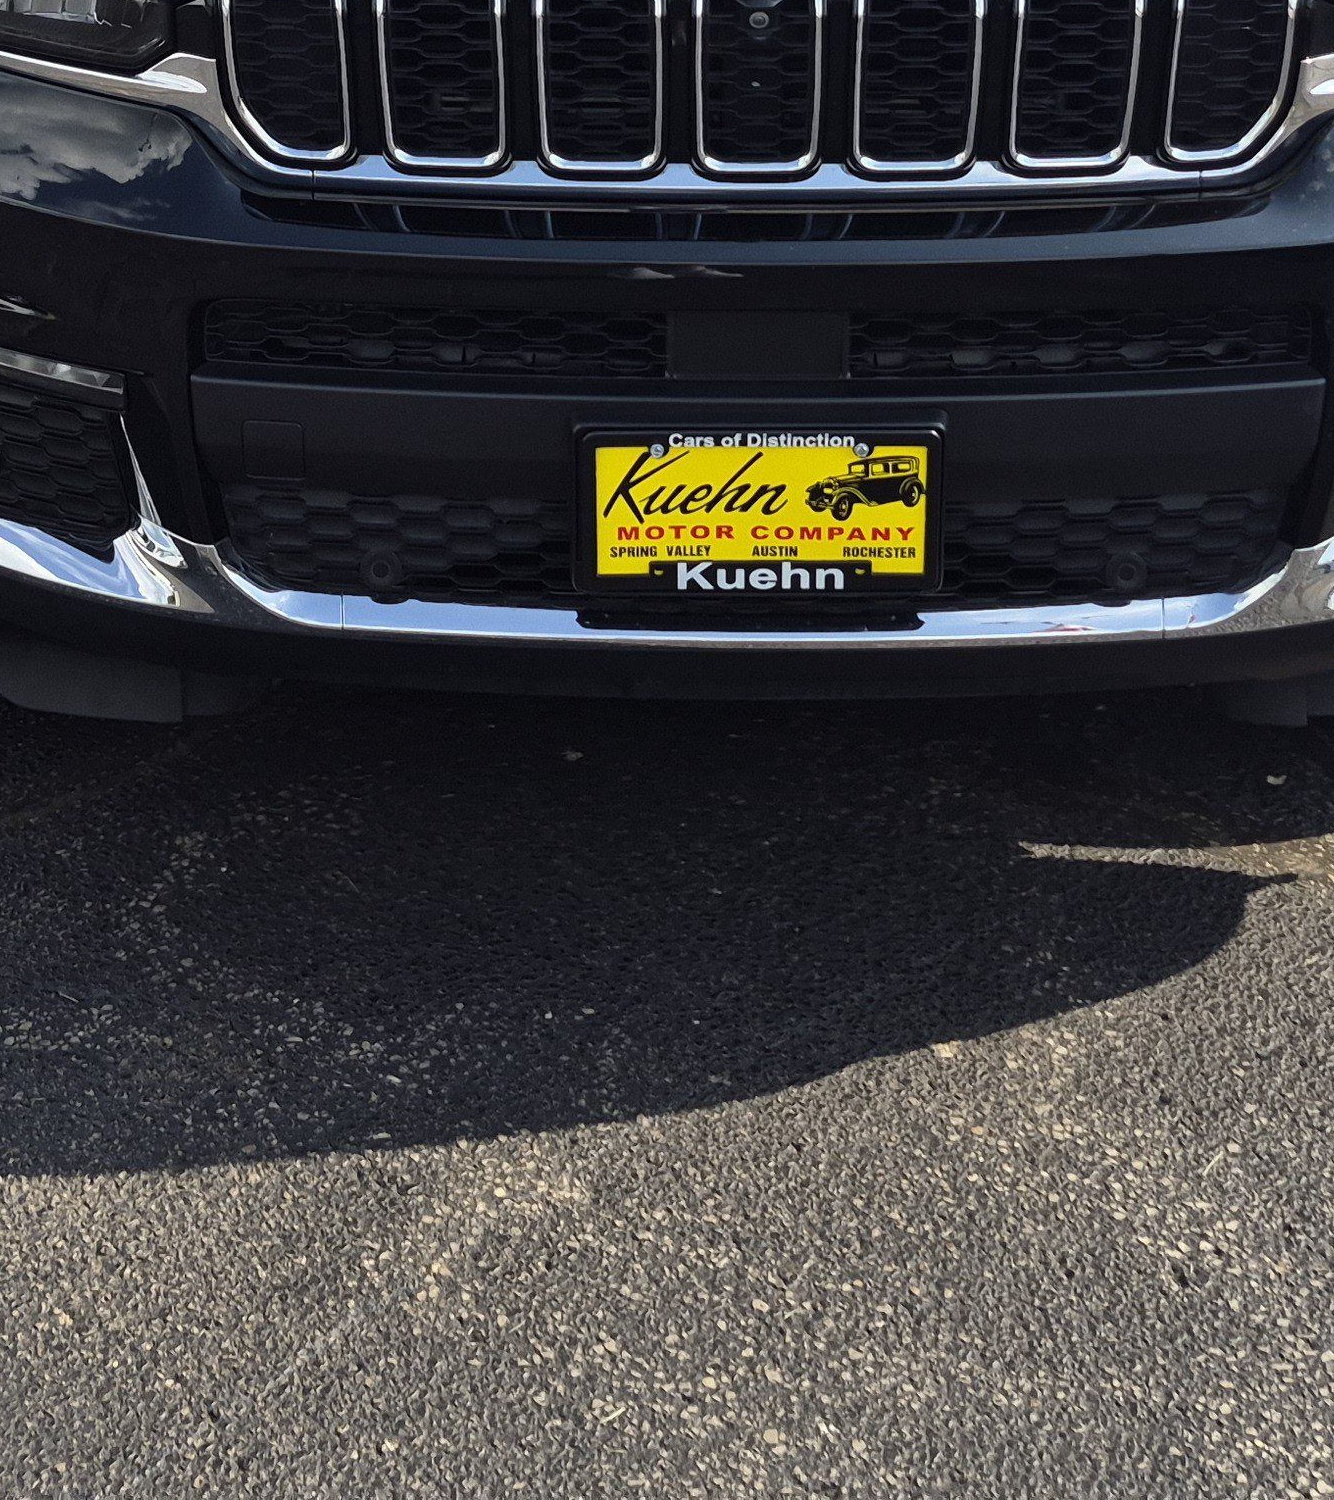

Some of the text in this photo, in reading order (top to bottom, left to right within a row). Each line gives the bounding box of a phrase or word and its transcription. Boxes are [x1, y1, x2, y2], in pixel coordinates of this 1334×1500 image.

[668, 433, 855, 449] Cars of Distinction
[603, 450, 788, 524] Kuehn
[617, 525, 916, 542] MOTOR COMPANY
[609, 545, 916, 558] SPRING VALLEY AUSTIN ROCHESTER
[677, 562, 845, 590] Kuehn
